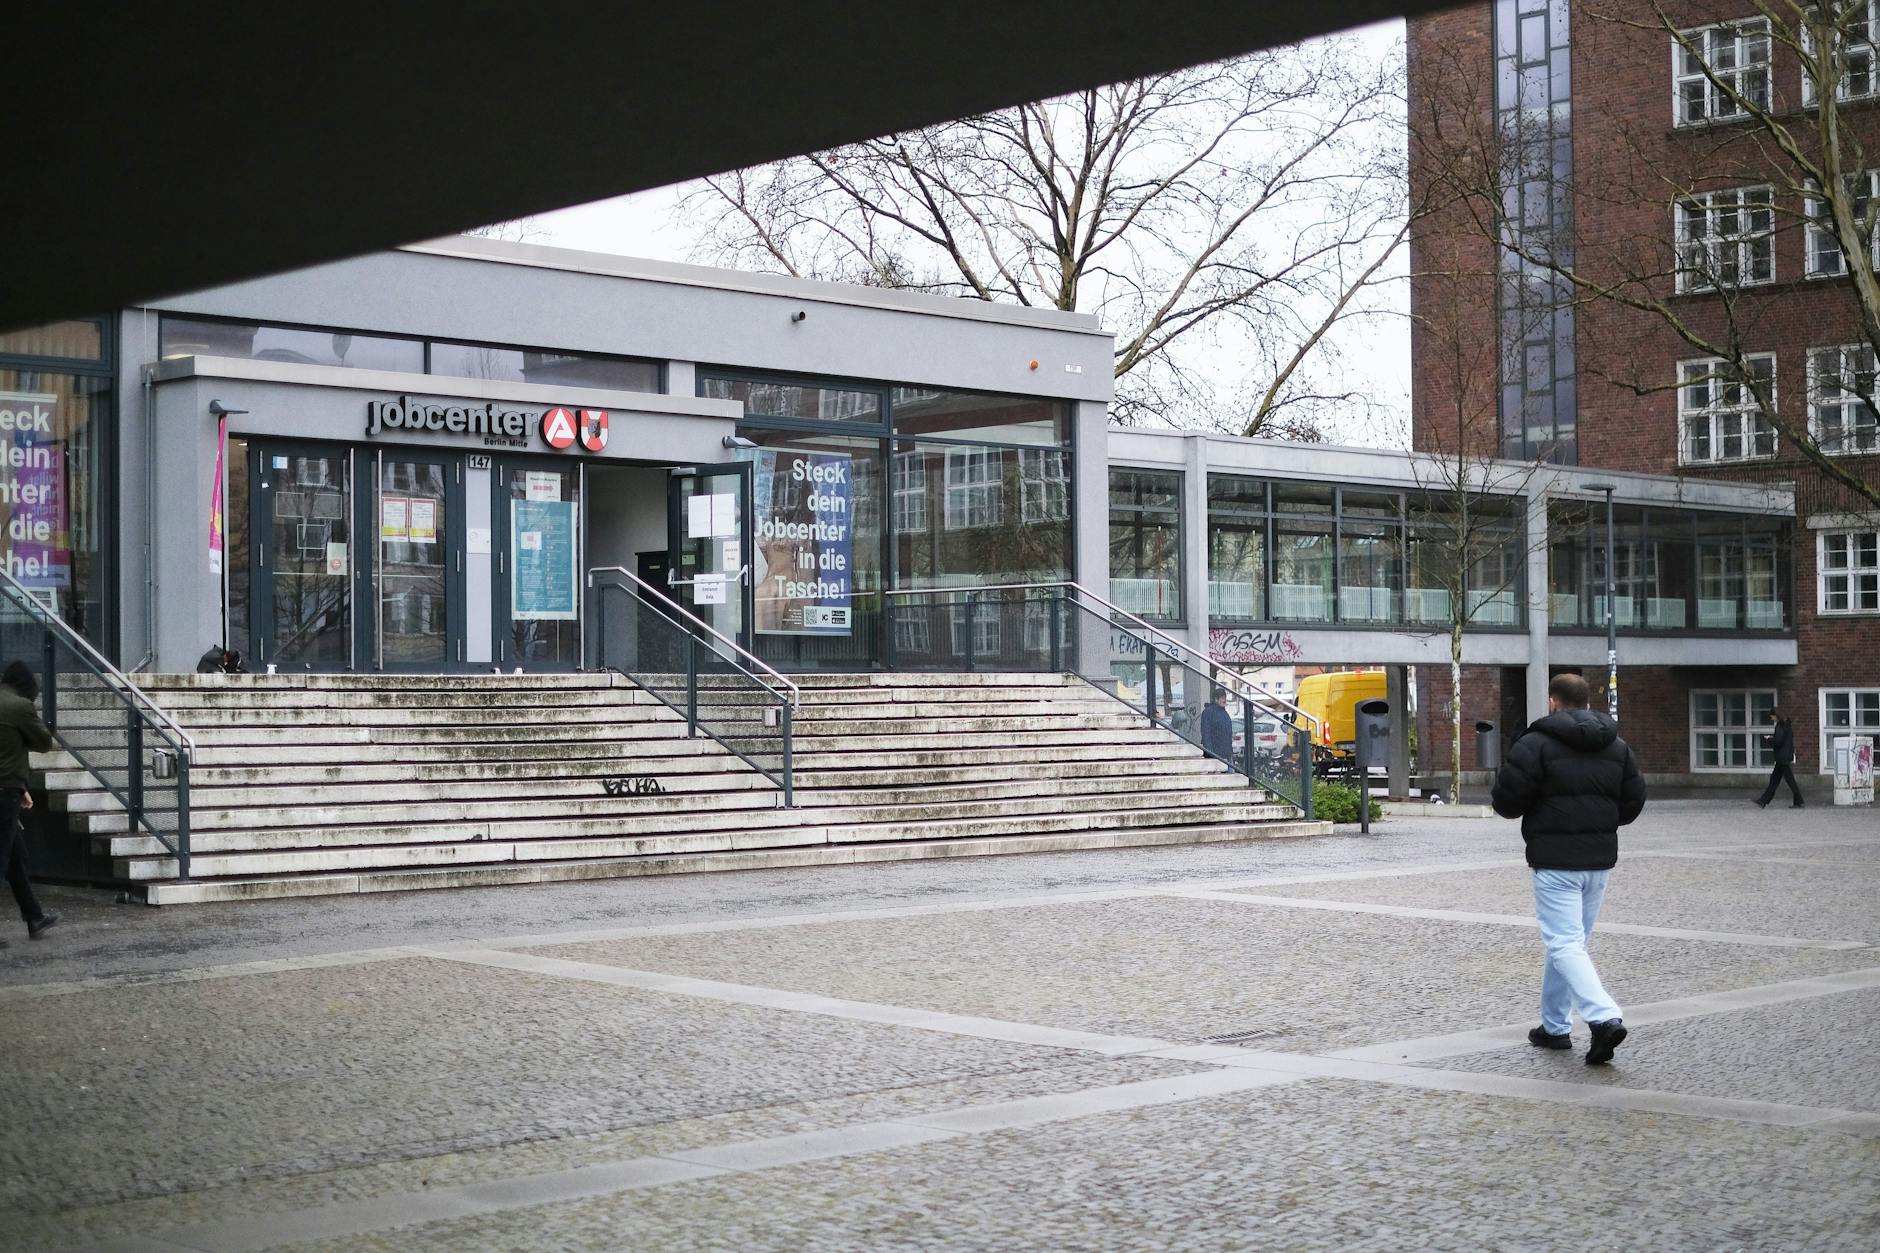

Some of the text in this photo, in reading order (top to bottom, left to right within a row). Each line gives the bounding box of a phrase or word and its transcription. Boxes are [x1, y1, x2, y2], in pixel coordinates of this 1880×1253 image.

[366, 395, 538, 437] jobcenter
[484, 437, 528, 449] Berlin Mitte
[471, 455, 490, 468] 147
[792, 458, 846, 484] Steck
[807, 489, 846, 513] dein
[9, 512, 50, 541] die
[754, 515, 847, 542] Jobcenter
[799, 546, 846, 571] in die
[774, 575, 845, 600] Tasche!
